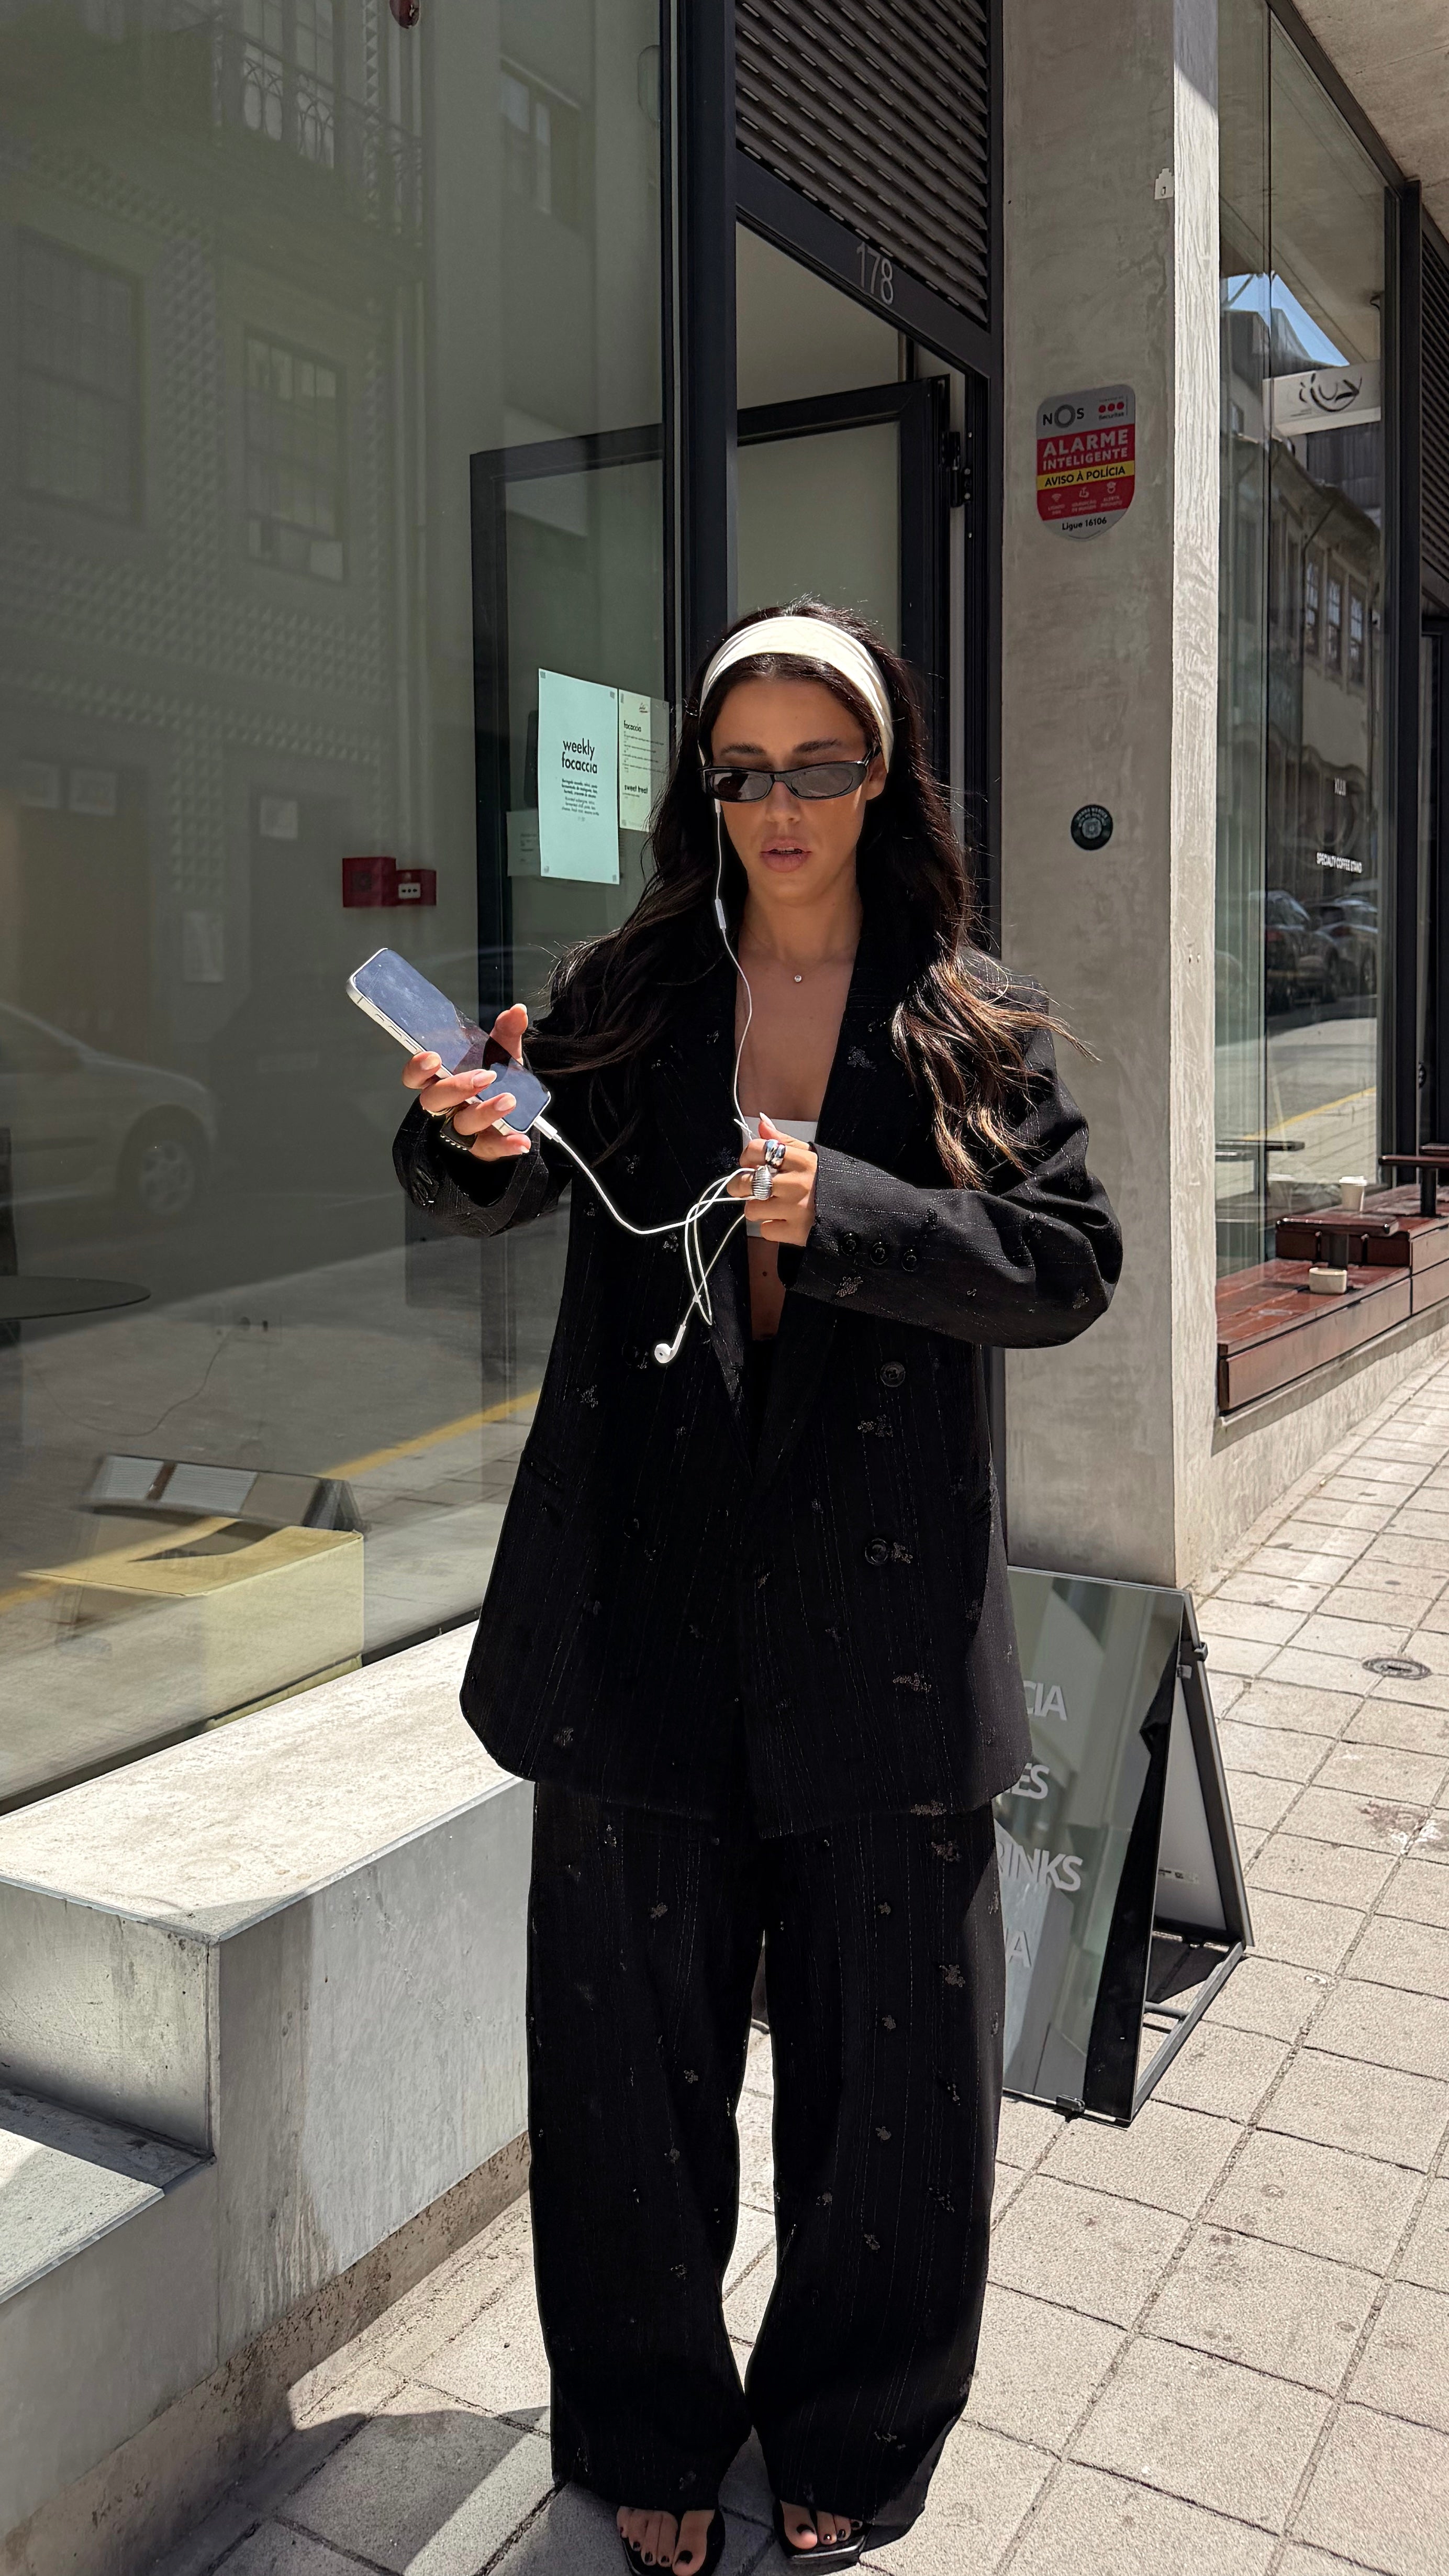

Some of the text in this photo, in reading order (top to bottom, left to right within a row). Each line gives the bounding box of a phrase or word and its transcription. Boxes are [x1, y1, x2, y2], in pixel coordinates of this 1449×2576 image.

[856, 241, 894, 305] 178
[1043, 404, 1085, 428] NOS
[1043, 429, 1128, 457] ALARME
[1043, 448, 1128, 471] INTELIGENTE
[1045, 465, 1125, 486] AVISO À POLÍCIA
[1062, 517, 1107, 531] Ligue 16106
[624, 720, 642, 732] focaccia
[563, 737, 595, 761] weekly
[562, 751, 597, 774] focaccia
[1336, 857, 1351, 871] COFFEE
